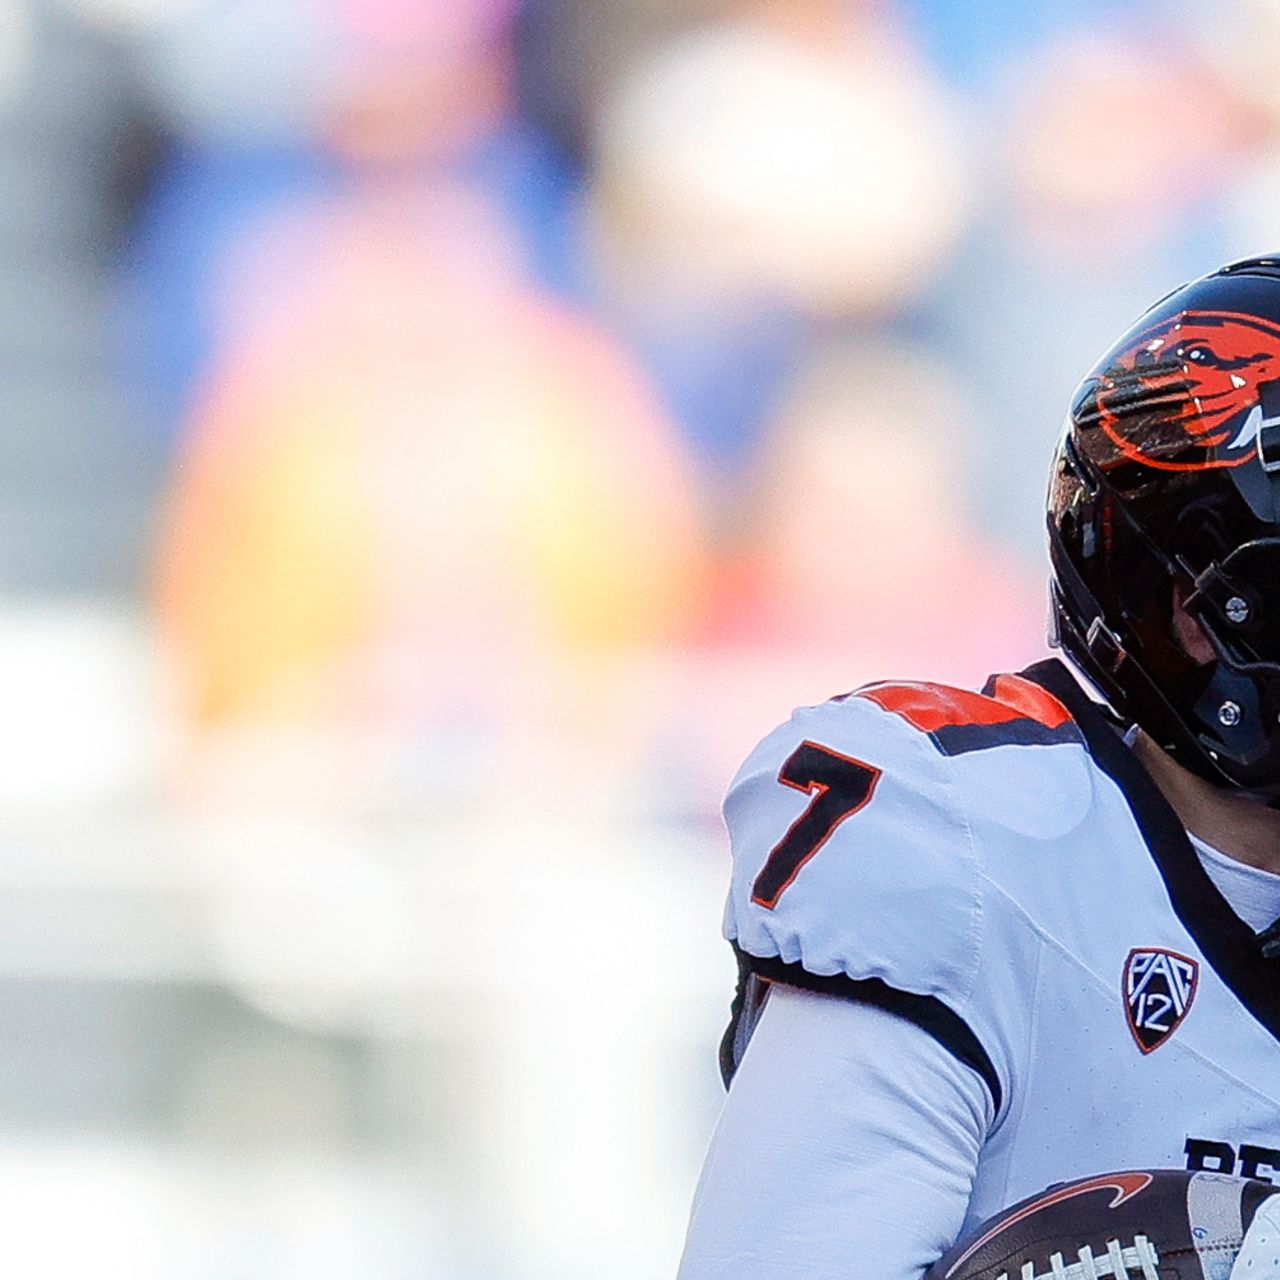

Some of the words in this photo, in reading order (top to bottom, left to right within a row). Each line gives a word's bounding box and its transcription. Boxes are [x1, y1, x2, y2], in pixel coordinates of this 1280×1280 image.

[750, 740, 883, 911] 7
[1128, 953, 1194, 1018] PAC
[1136, 992, 1170, 1033] 12
